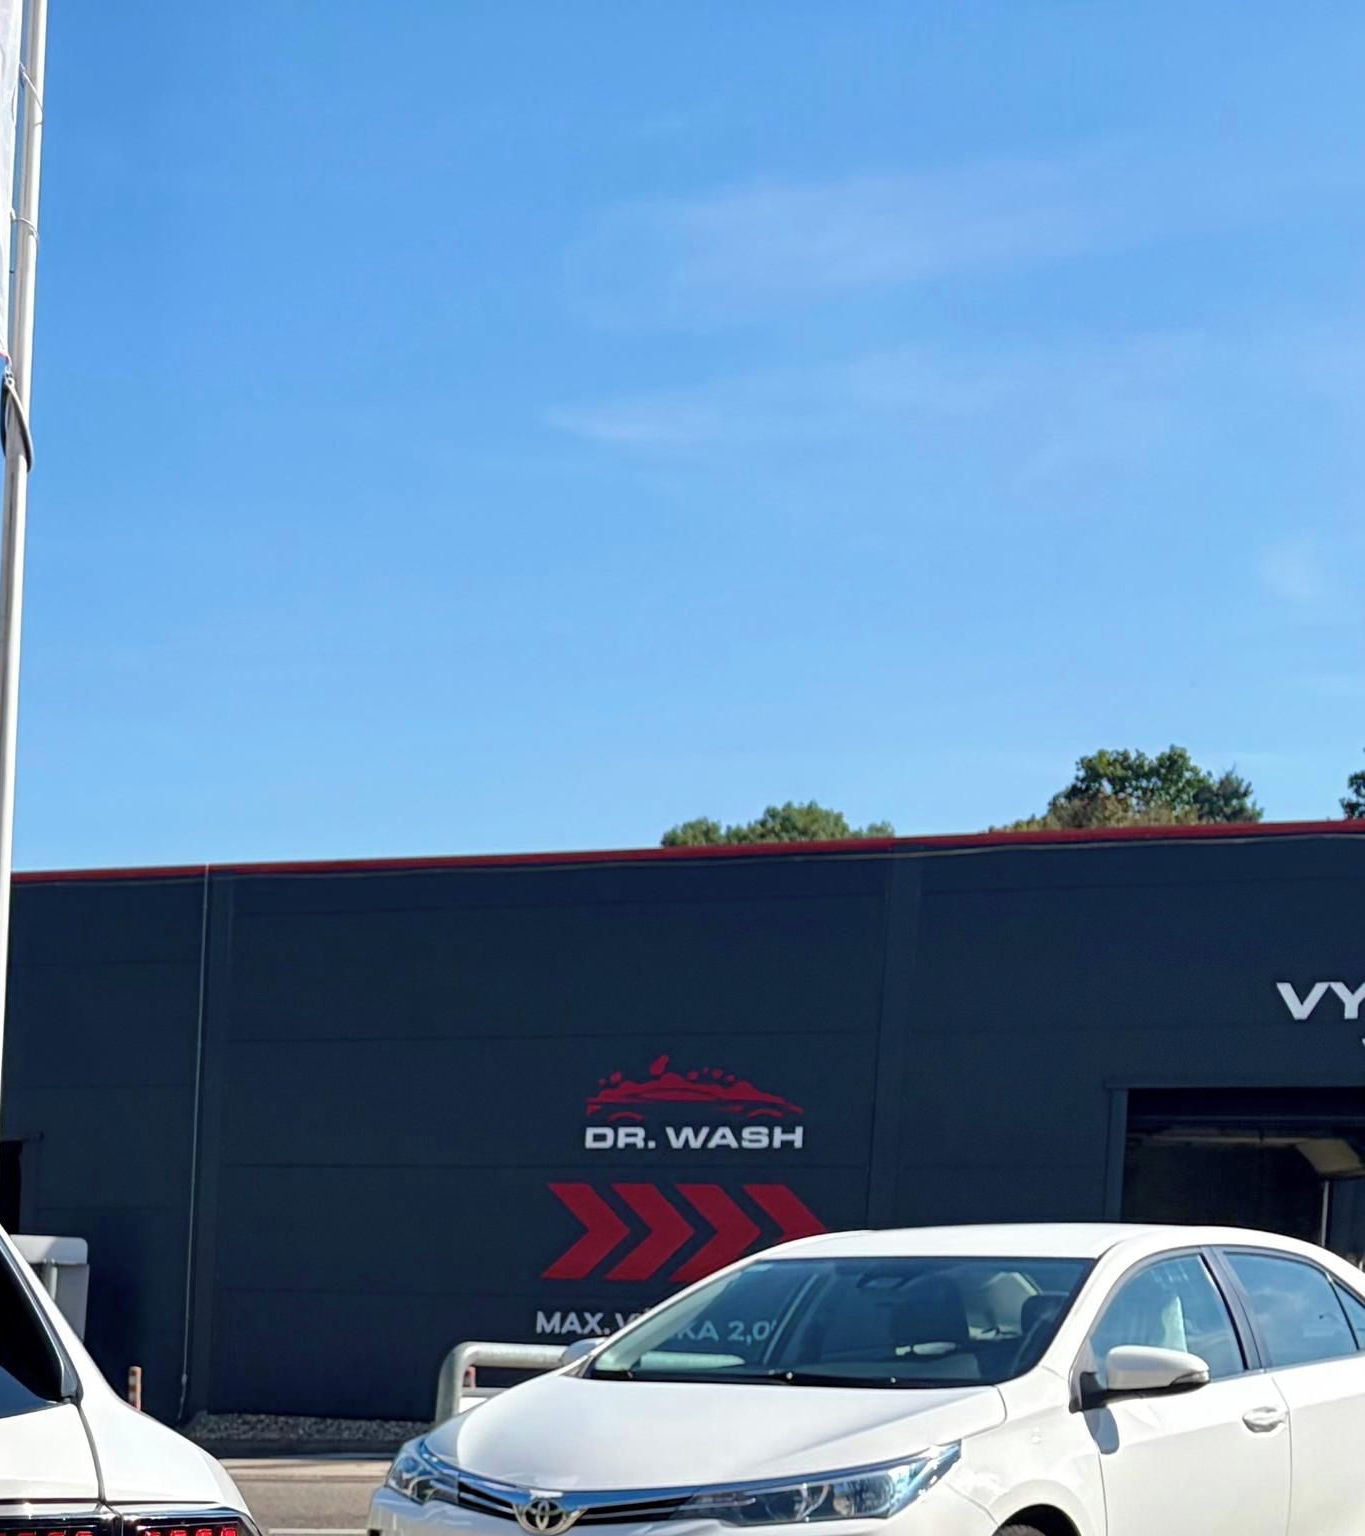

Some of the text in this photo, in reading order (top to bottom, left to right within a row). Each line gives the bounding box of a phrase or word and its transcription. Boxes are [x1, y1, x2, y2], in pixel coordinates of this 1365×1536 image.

[584, 1126, 804, 1149] DR. WASH
[535, 1310, 611, 1335] MAX.
